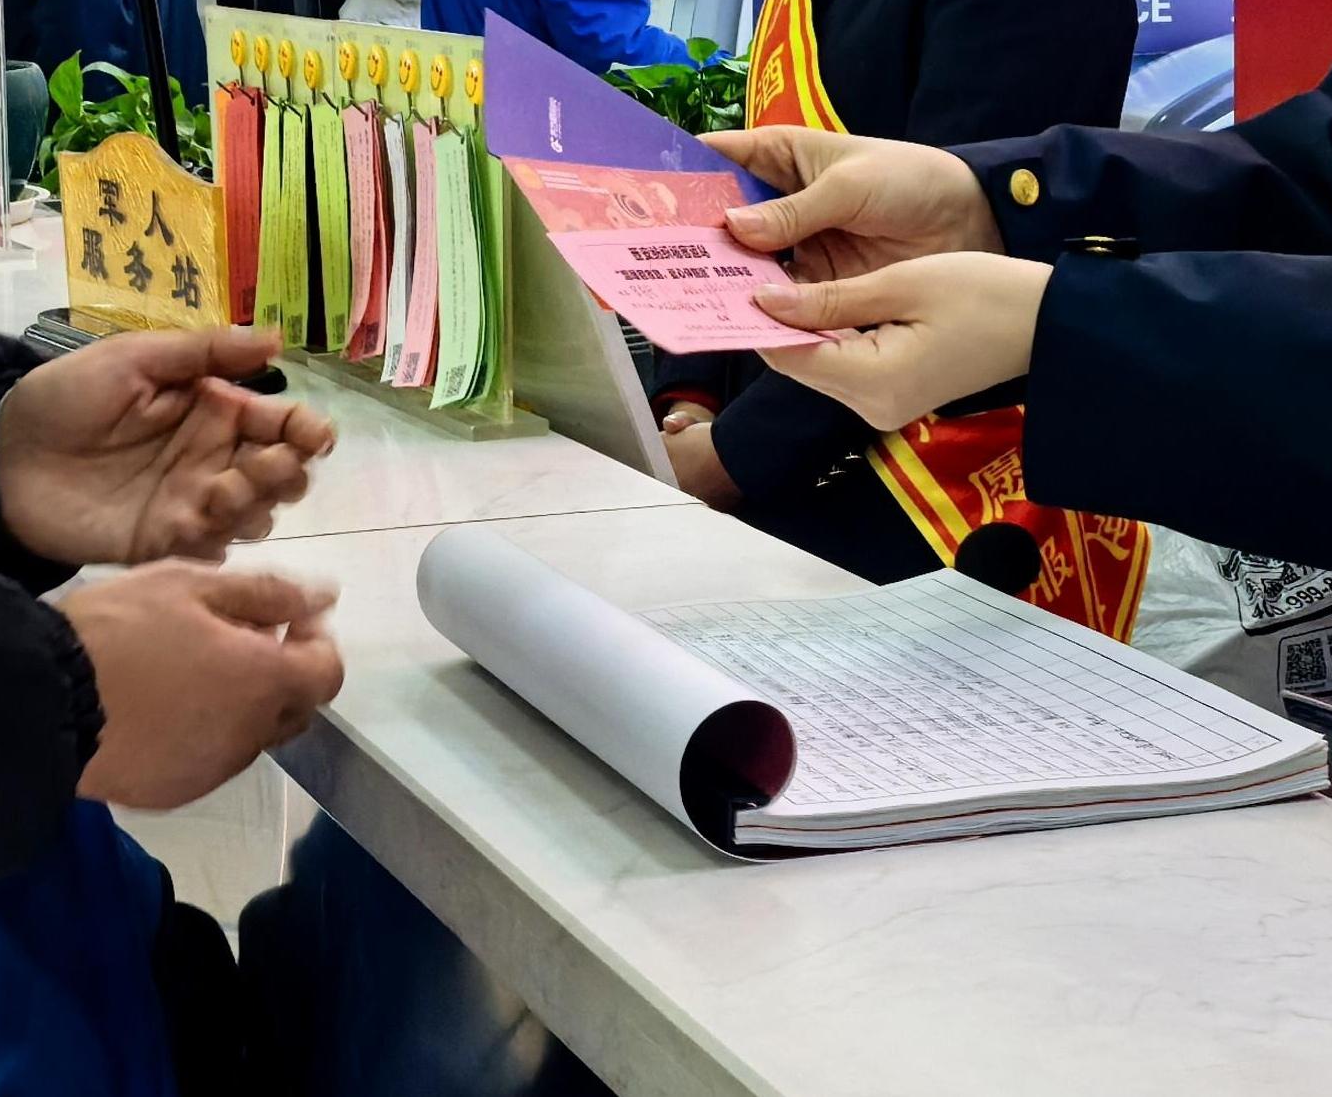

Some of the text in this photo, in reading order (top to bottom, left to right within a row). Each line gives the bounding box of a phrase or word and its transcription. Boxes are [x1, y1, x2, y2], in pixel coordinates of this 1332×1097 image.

[99, 177, 175, 247] 军人
[81, 227, 201, 310] 服务站
